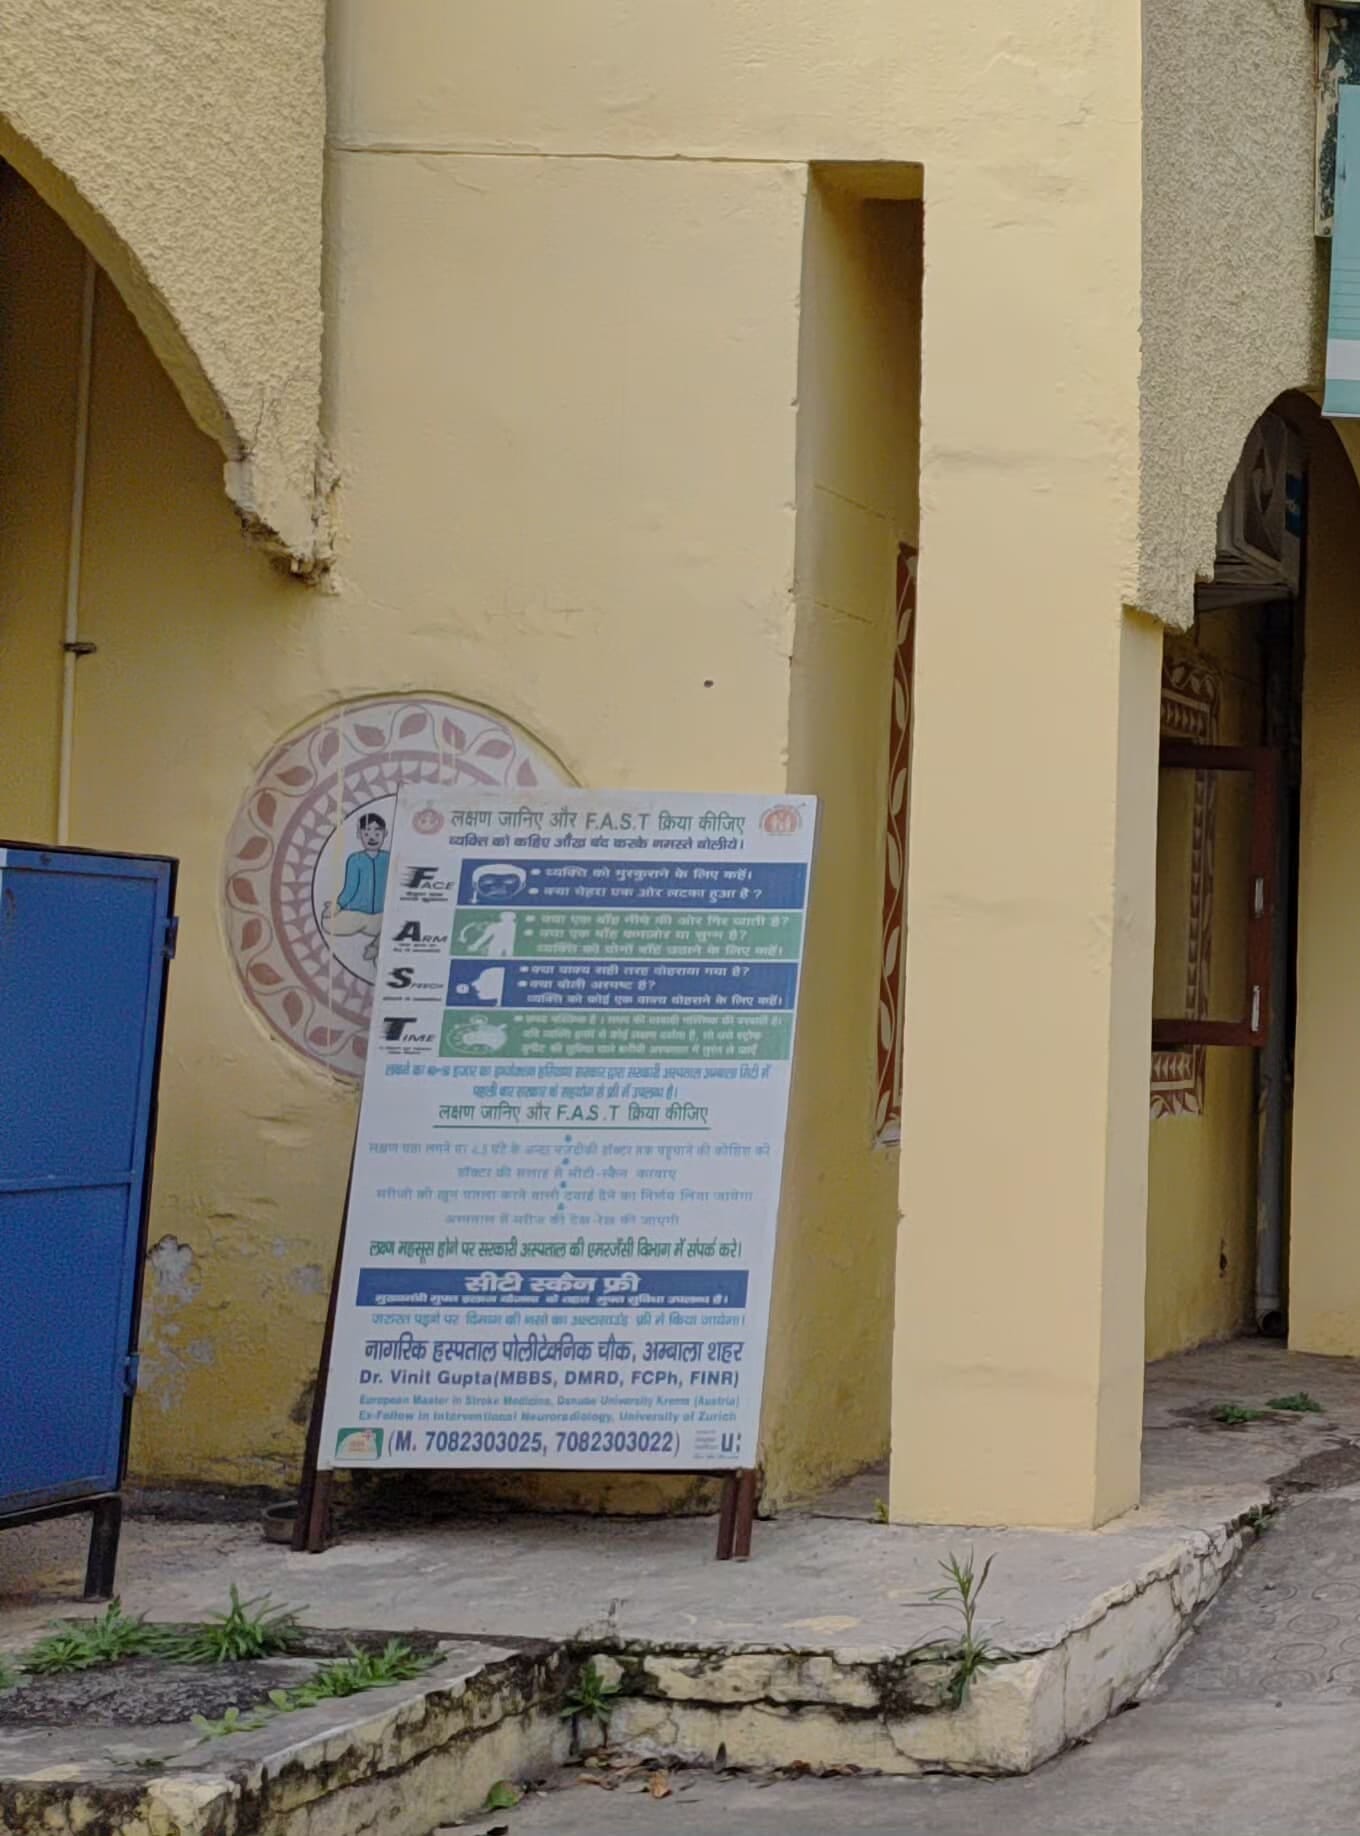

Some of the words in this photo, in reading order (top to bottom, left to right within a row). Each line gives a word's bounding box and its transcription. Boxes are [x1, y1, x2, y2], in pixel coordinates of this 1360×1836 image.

[450, 809, 492, 828] लक्षण
[498, 806, 544, 830] जानिए
[551, 806, 577, 828] और
[585, 812, 651, 830] F.A.S.T
[658, 809, 694, 832] क्रिया
[698, 810, 746, 835] कीजिए
[449, 832, 489, 848] व्यक्ति
[491, 832, 510, 848] को
[513, 833, 550, 848] कहिए
[400, 865, 456, 890] FACE
[392, 920, 449, 943] ARM
[380, 1016, 437, 1043] TIME
[438, 1104, 476, 1121] लक्षण
[480, 1101, 521, 1123] जानिए
[525, 1101, 553, 1121] और
[628, 1102, 661, 1121] क्रिया
[665, 1102, 710, 1123] कीजिए
[399, 1240, 435, 1264] महसूस
[437, 1237, 458, 1258] होने
[461, 1241, 475, 1257] पर
[478, 1236, 518, 1257] सरकारी
[520, 1242, 567, 1258] अस्पताल
[569, 1236, 585, 1257] की
[674, 1237, 687, 1257] में
[463, 1271, 525, 1293] सीटी
[529, 1271, 598, 1293] स्कैन
[602, 1271, 643, 1294] फ्री
[365, 1331, 429, 1361] नागरिक
[433, 1340, 500, 1362] हस्पताल
[597, 1332, 637, 1363] चौक,
[642, 1341, 705, 1363] अम्बाला
[707, 1341, 746, 1364] शहर
[360, 1369, 383, 1385] Dr.
[391, 1368, 431, 1385] Vinit
[437, 1370, 558, 1388] Gupta(MBBS,
[565, 1371, 624, 1388] DMRD,
[631, 1371, 683, 1388] FCPh,
[690, 1371, 740, 1389] FINR)
[359, 1394, 409, 1407] European
[413, 1394, 449, 1406] Master
[452, 1394, 463, 1406] in
[466, 1394, 499, 1406] Stroke
[557, 1395, 597, 1407] Danube
[600, 1395, 652, 1409] University
[418, 1410, 430, 1422] in
[433, 1411, 517, 1422] Interventional
[619, 1411, 679, 1425] University
[683, 1411, 695, 1422] of
[698, 1411, 737, 1423] Zurich
[388, 1430, 417, 1456] (M.
[425, 1430, 548, 1456] 7082303025,
[555, 1431, 681, 1457] 7082303022)
